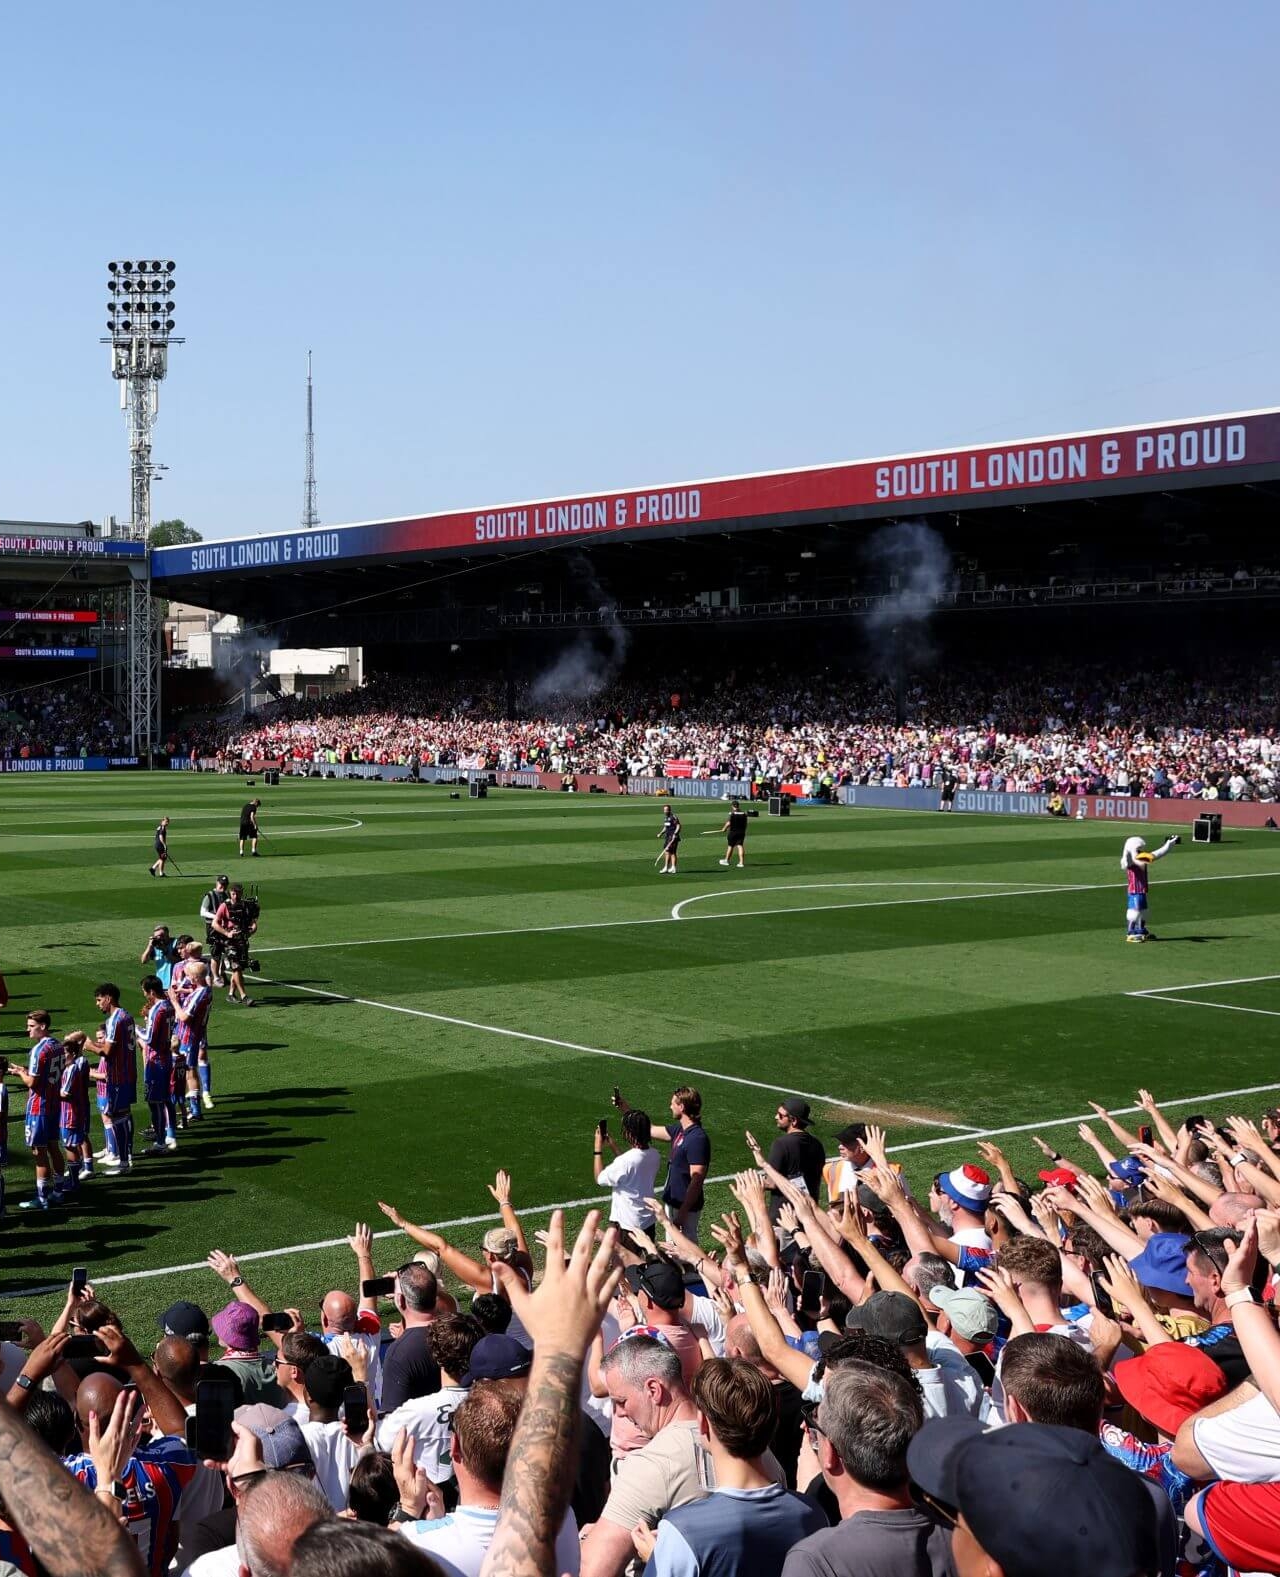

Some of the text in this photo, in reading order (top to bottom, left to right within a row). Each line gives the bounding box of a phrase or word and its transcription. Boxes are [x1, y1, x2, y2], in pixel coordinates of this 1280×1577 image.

[876, 424, 1246, 498] SOUTH LONDON & PROUD
[476, 490, 700, 540] SOUTH LONDON & PROUD
[30, 538, 66, 551] LONDON
[68, 540, 74, 551] &
[76, 540, 104, 552] PROUD
[192, 533, 339, 571] SOUTH LONDON & PROUD
[6, 760, 41, 772] LONDON
[46, 760, 52, 771] &
[55, 758, 84, 770] PROUD
[712, 782, 718, 796] &
[958, 793, 1003, 812] SOUTH
[1095, 799, 1148, 819] PROUD
[126, 1482, 156, 1504] ELS
